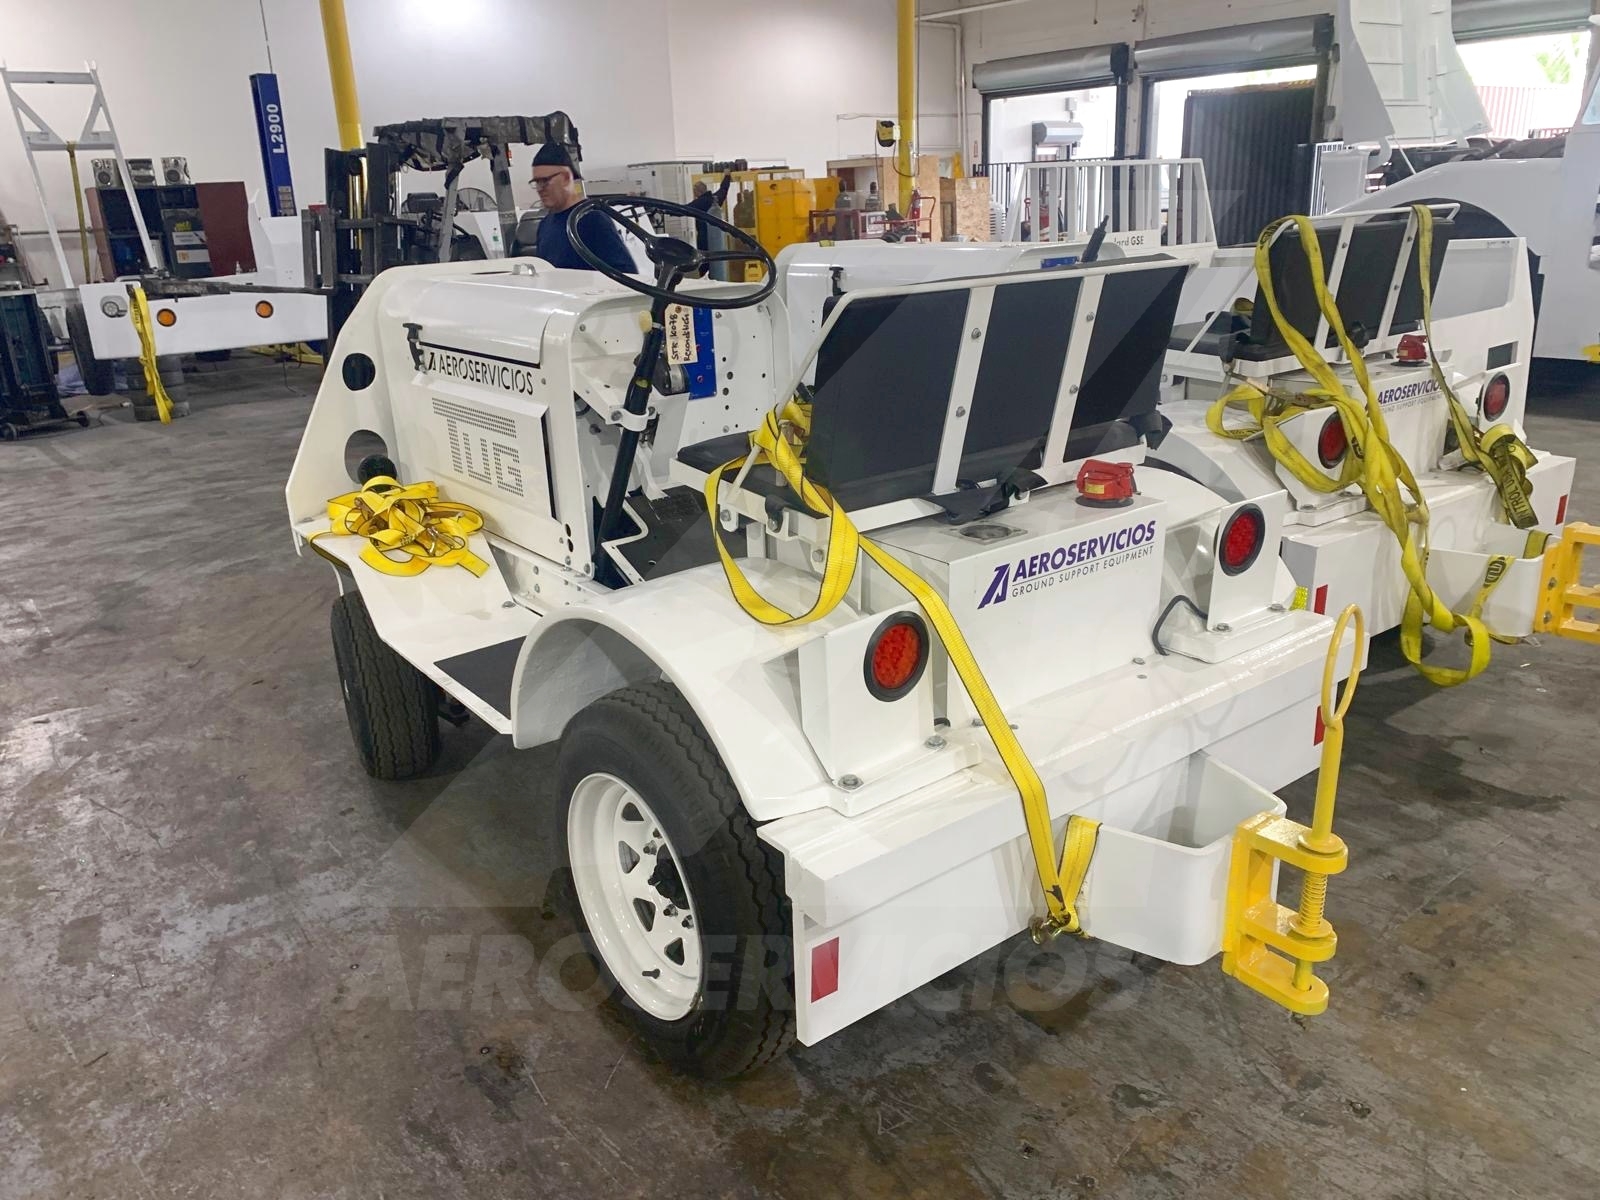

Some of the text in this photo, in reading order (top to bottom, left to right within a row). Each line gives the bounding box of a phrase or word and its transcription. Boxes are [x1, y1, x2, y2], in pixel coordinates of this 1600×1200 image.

[267, 104, 285, 154] L2900
[1131, 236, 1144, 246] GSE
[438, 353, 534, 396] AEROSERVICIOS
[1378, 379, 1442, 404] AEROSERVICIO
[432, 398, 524, 497] TUG
[1012, 520, 1156, 582] AEROSERVICIOS
[1012, 546, 1154, 598] GROUND SUPPORT EQUIPMENT
